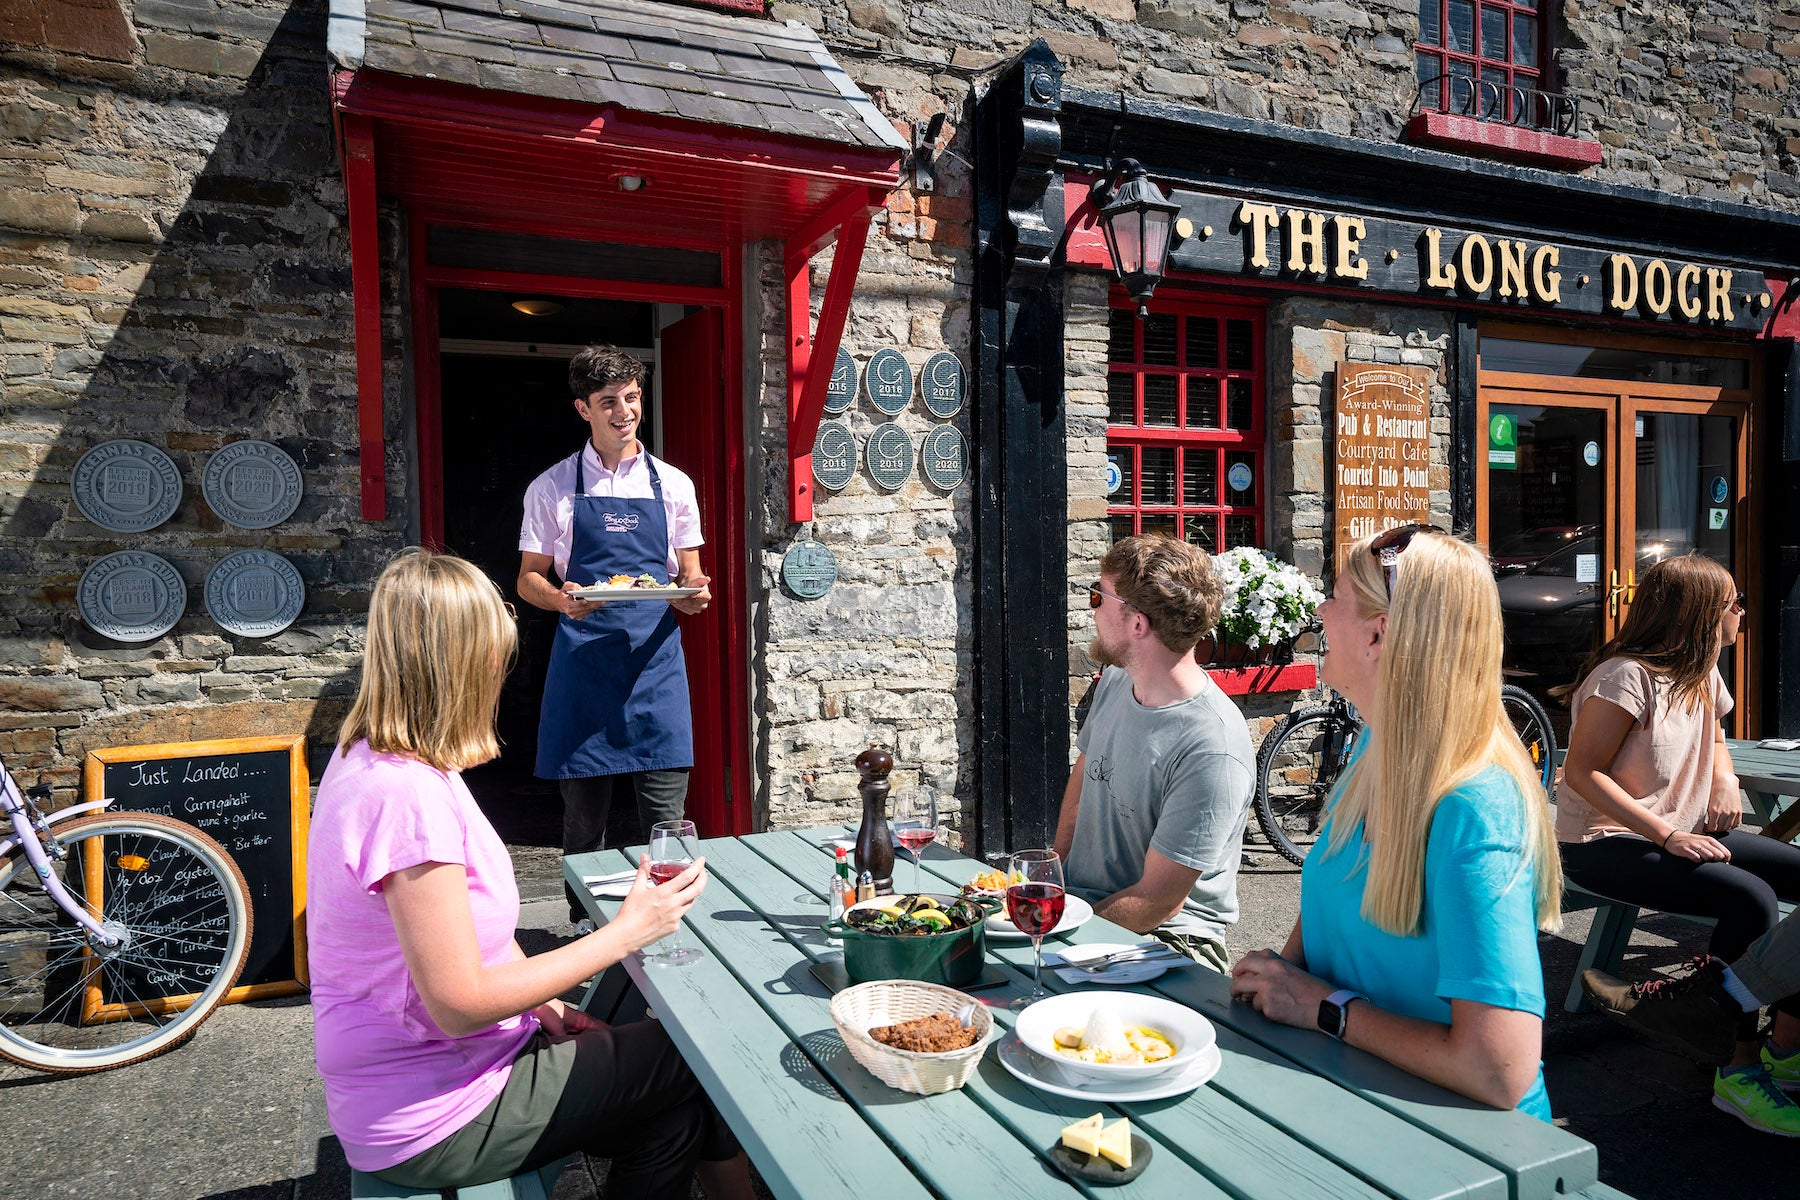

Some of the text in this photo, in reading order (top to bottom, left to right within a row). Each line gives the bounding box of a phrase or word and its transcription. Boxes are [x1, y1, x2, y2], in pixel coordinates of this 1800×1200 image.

[1239, 201, 1735, 322] THE LONG DOCK
[827, 382, 847, 391] 015
[878, 384, 903, 394] 2016
[1358, 374, 1410, 386] Welcome to Our
[932, 388, 956, 397] 2017
[1345, 400, 1423, 415] Award-Winning
[1338, 412, 1427, 439] Pub & Restaurant
[1338, 439, 1428, 464] Courtyard Cafe
[822, 459, 847, 468] 2018
[879, 459, 904, 468] 2019
[935, 460, 958, 469] 2020
[148, 453, 179, 500] GUIDES
[271, 453, 299, 497] GUIDES
[1338, 464, 1429, 488] Tourist Info Point
[108, 481, 145, 495] 2019
[235, 480, 271, 494] 2020
[1338, 489, 1428, 511] Artisan Food Store
[148, 561, 183, 605] GUIDES
[271, 559, 301, 604] GUIDES
[113, 591, 151, 605] 2018
[238, 589, 272, 601] 2017
[128, 762, 169, 786] Just
[184, 792, 251, 816] Carrigaholt
[197, 818, 220, 828] wine
[232, 809, 267, 830] garlic
[233, 833, 272, 851] Butter
[147, 968, 186, 987] Caught
[196, 963, 219, 976] Cod
